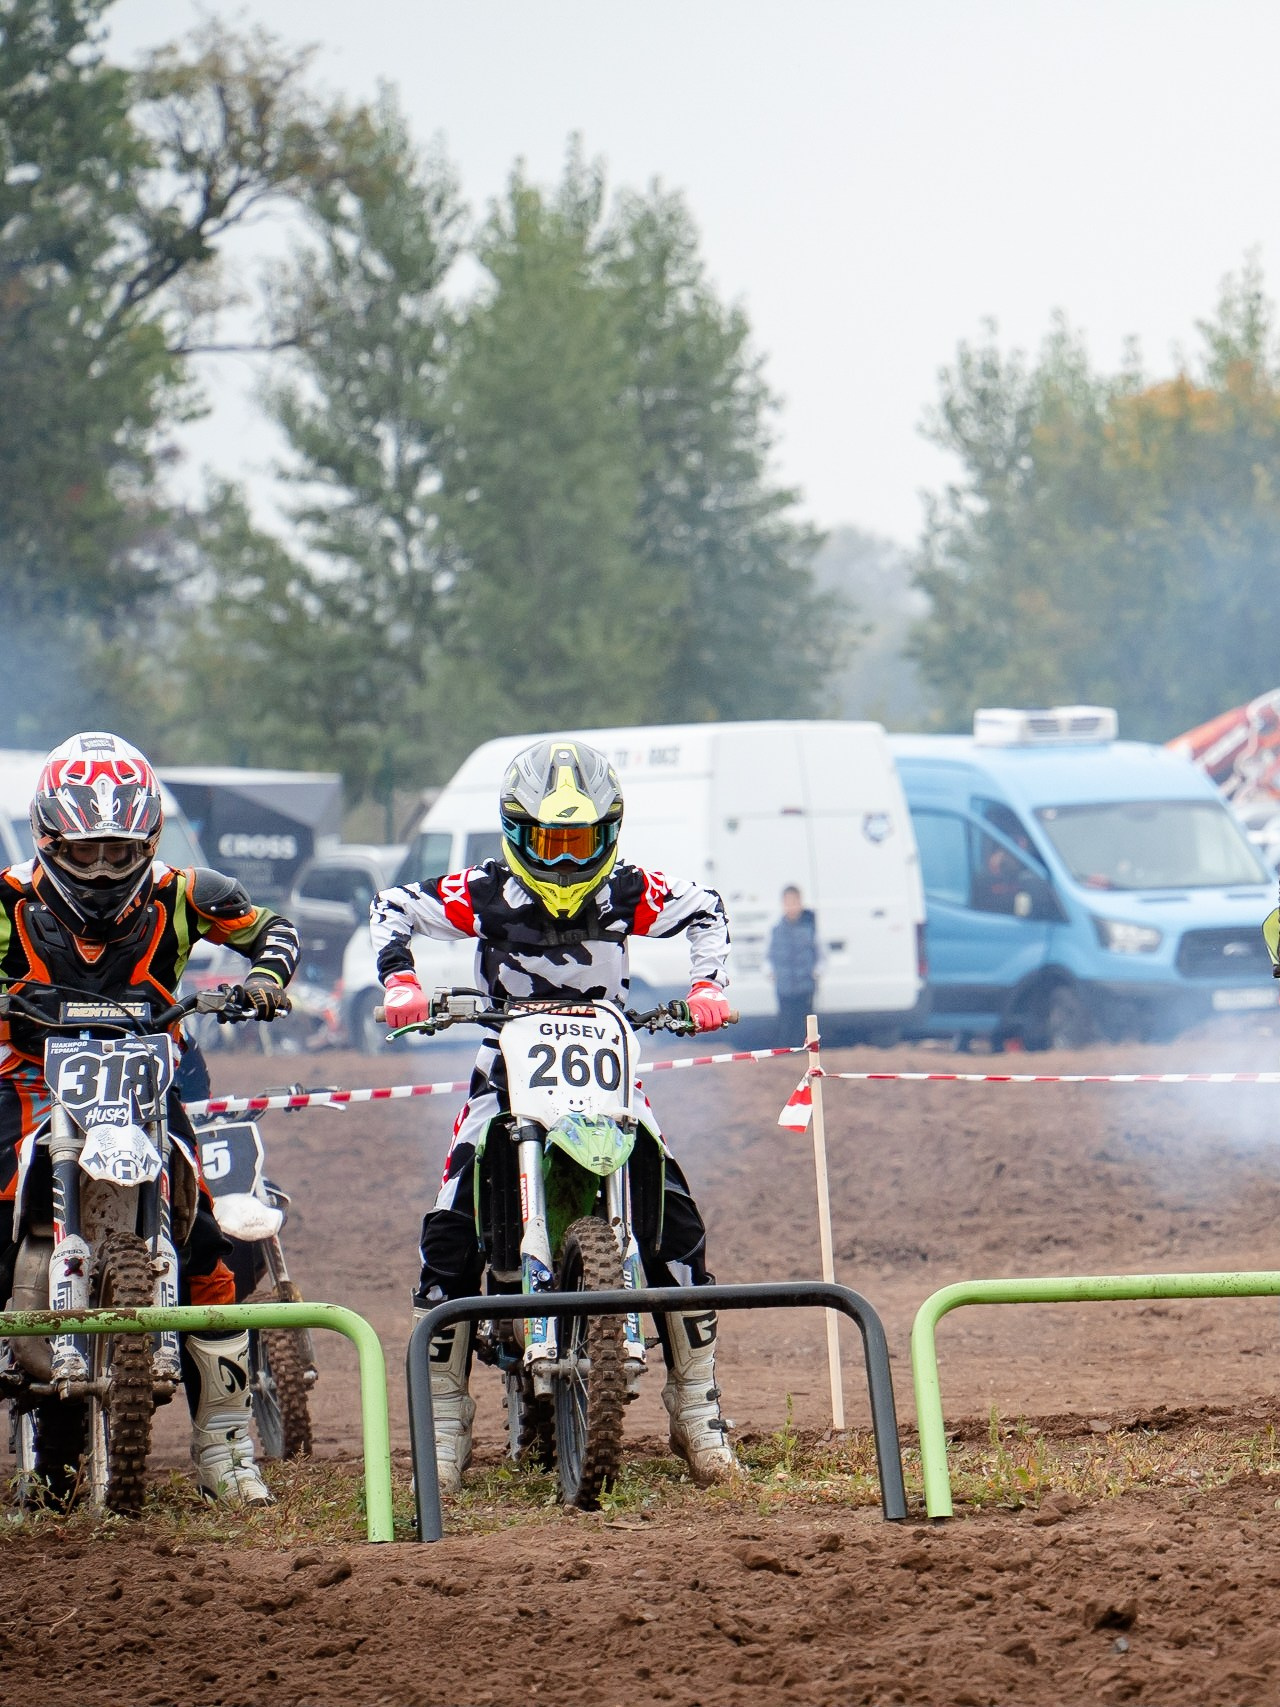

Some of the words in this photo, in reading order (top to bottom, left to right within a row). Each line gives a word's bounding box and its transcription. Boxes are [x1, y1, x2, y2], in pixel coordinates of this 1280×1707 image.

[219, 833, 297, 860] CROSS
[66, 1006, 147, 1018] RENTHAL
[540, 1023, 605, 1040] GUSEV
[50, 1047, 79, 1055] ГЕРМАН
[528, 1043, 621, 1092] 260
[61, 1055, 159, 1106] 318
